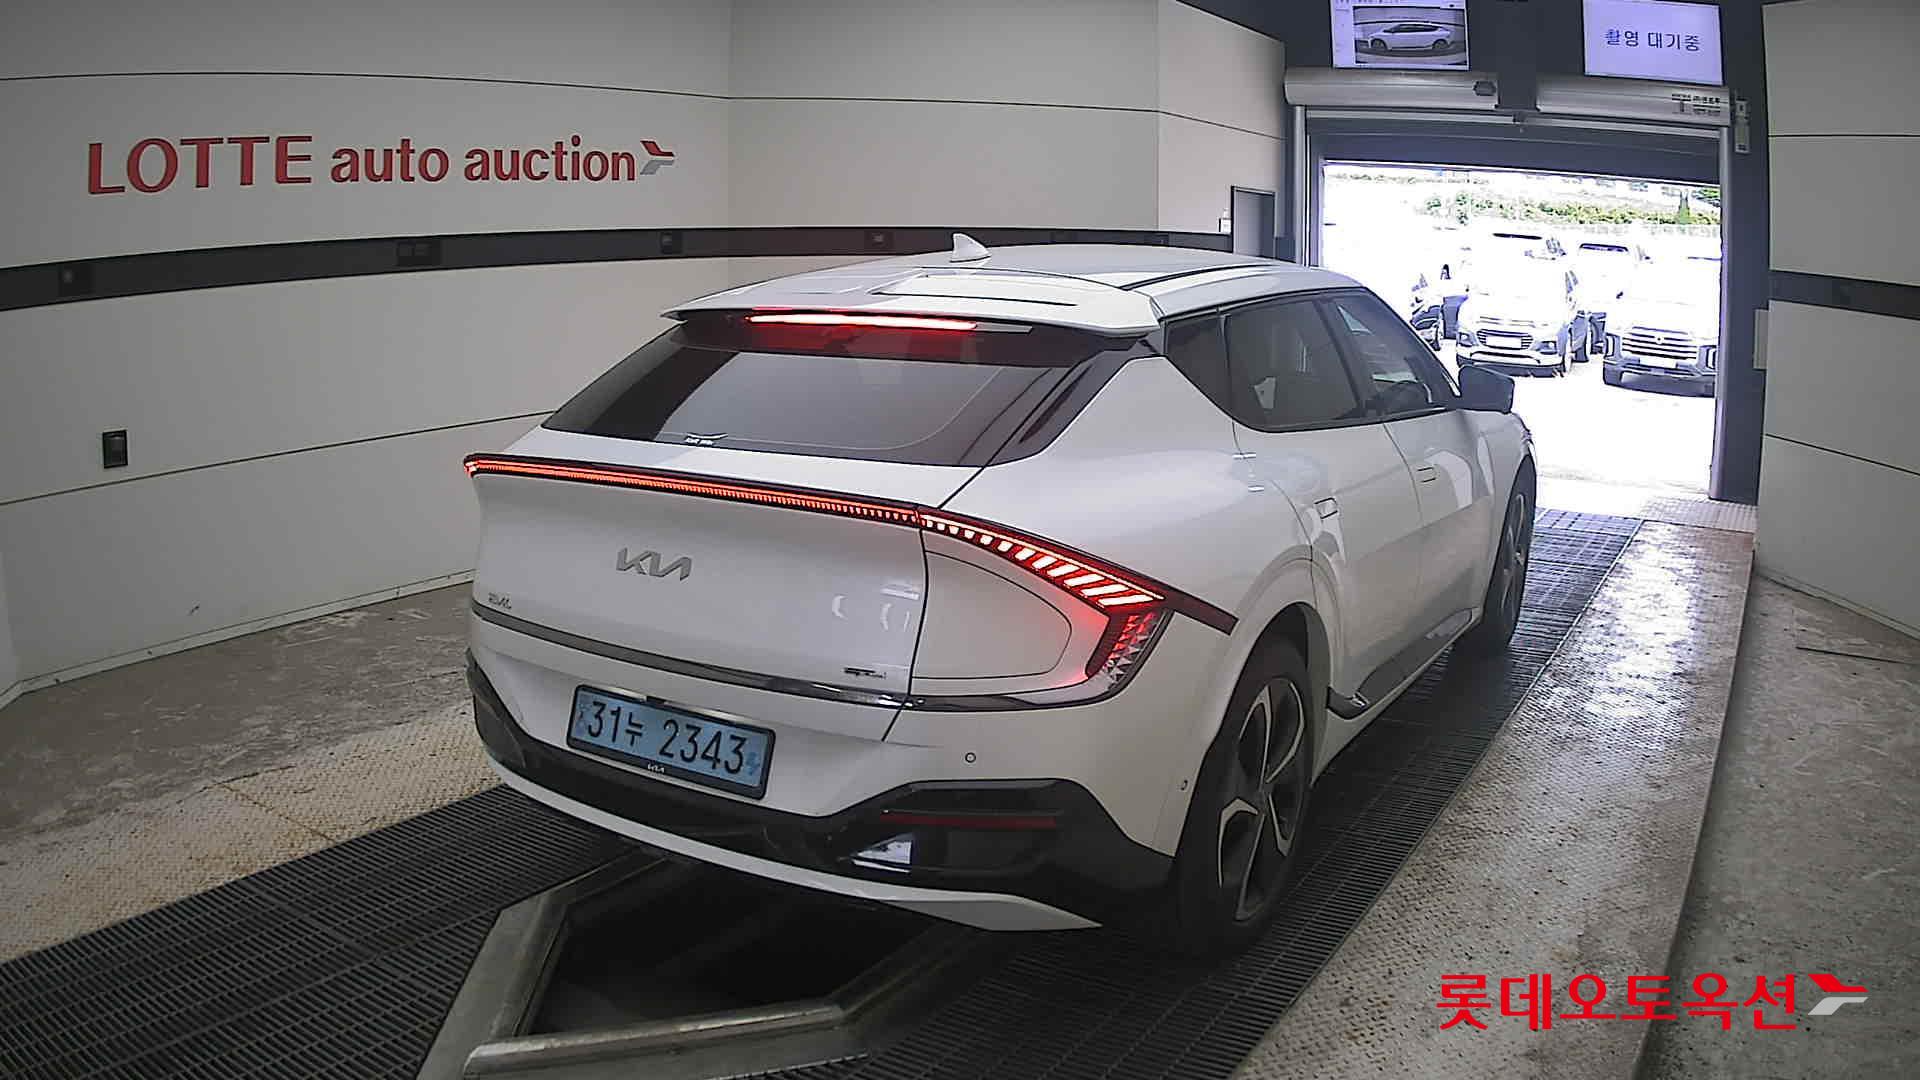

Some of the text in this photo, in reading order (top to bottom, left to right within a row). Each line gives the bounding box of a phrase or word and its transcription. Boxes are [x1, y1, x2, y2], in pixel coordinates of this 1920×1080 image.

[1647, 31, 1701, 52] 대기중
[87, 134, 637, 195] LOTTE auto auction
[616, 547, 692, 581] KIA
[587, 700, 748, 775] 31누 2343
